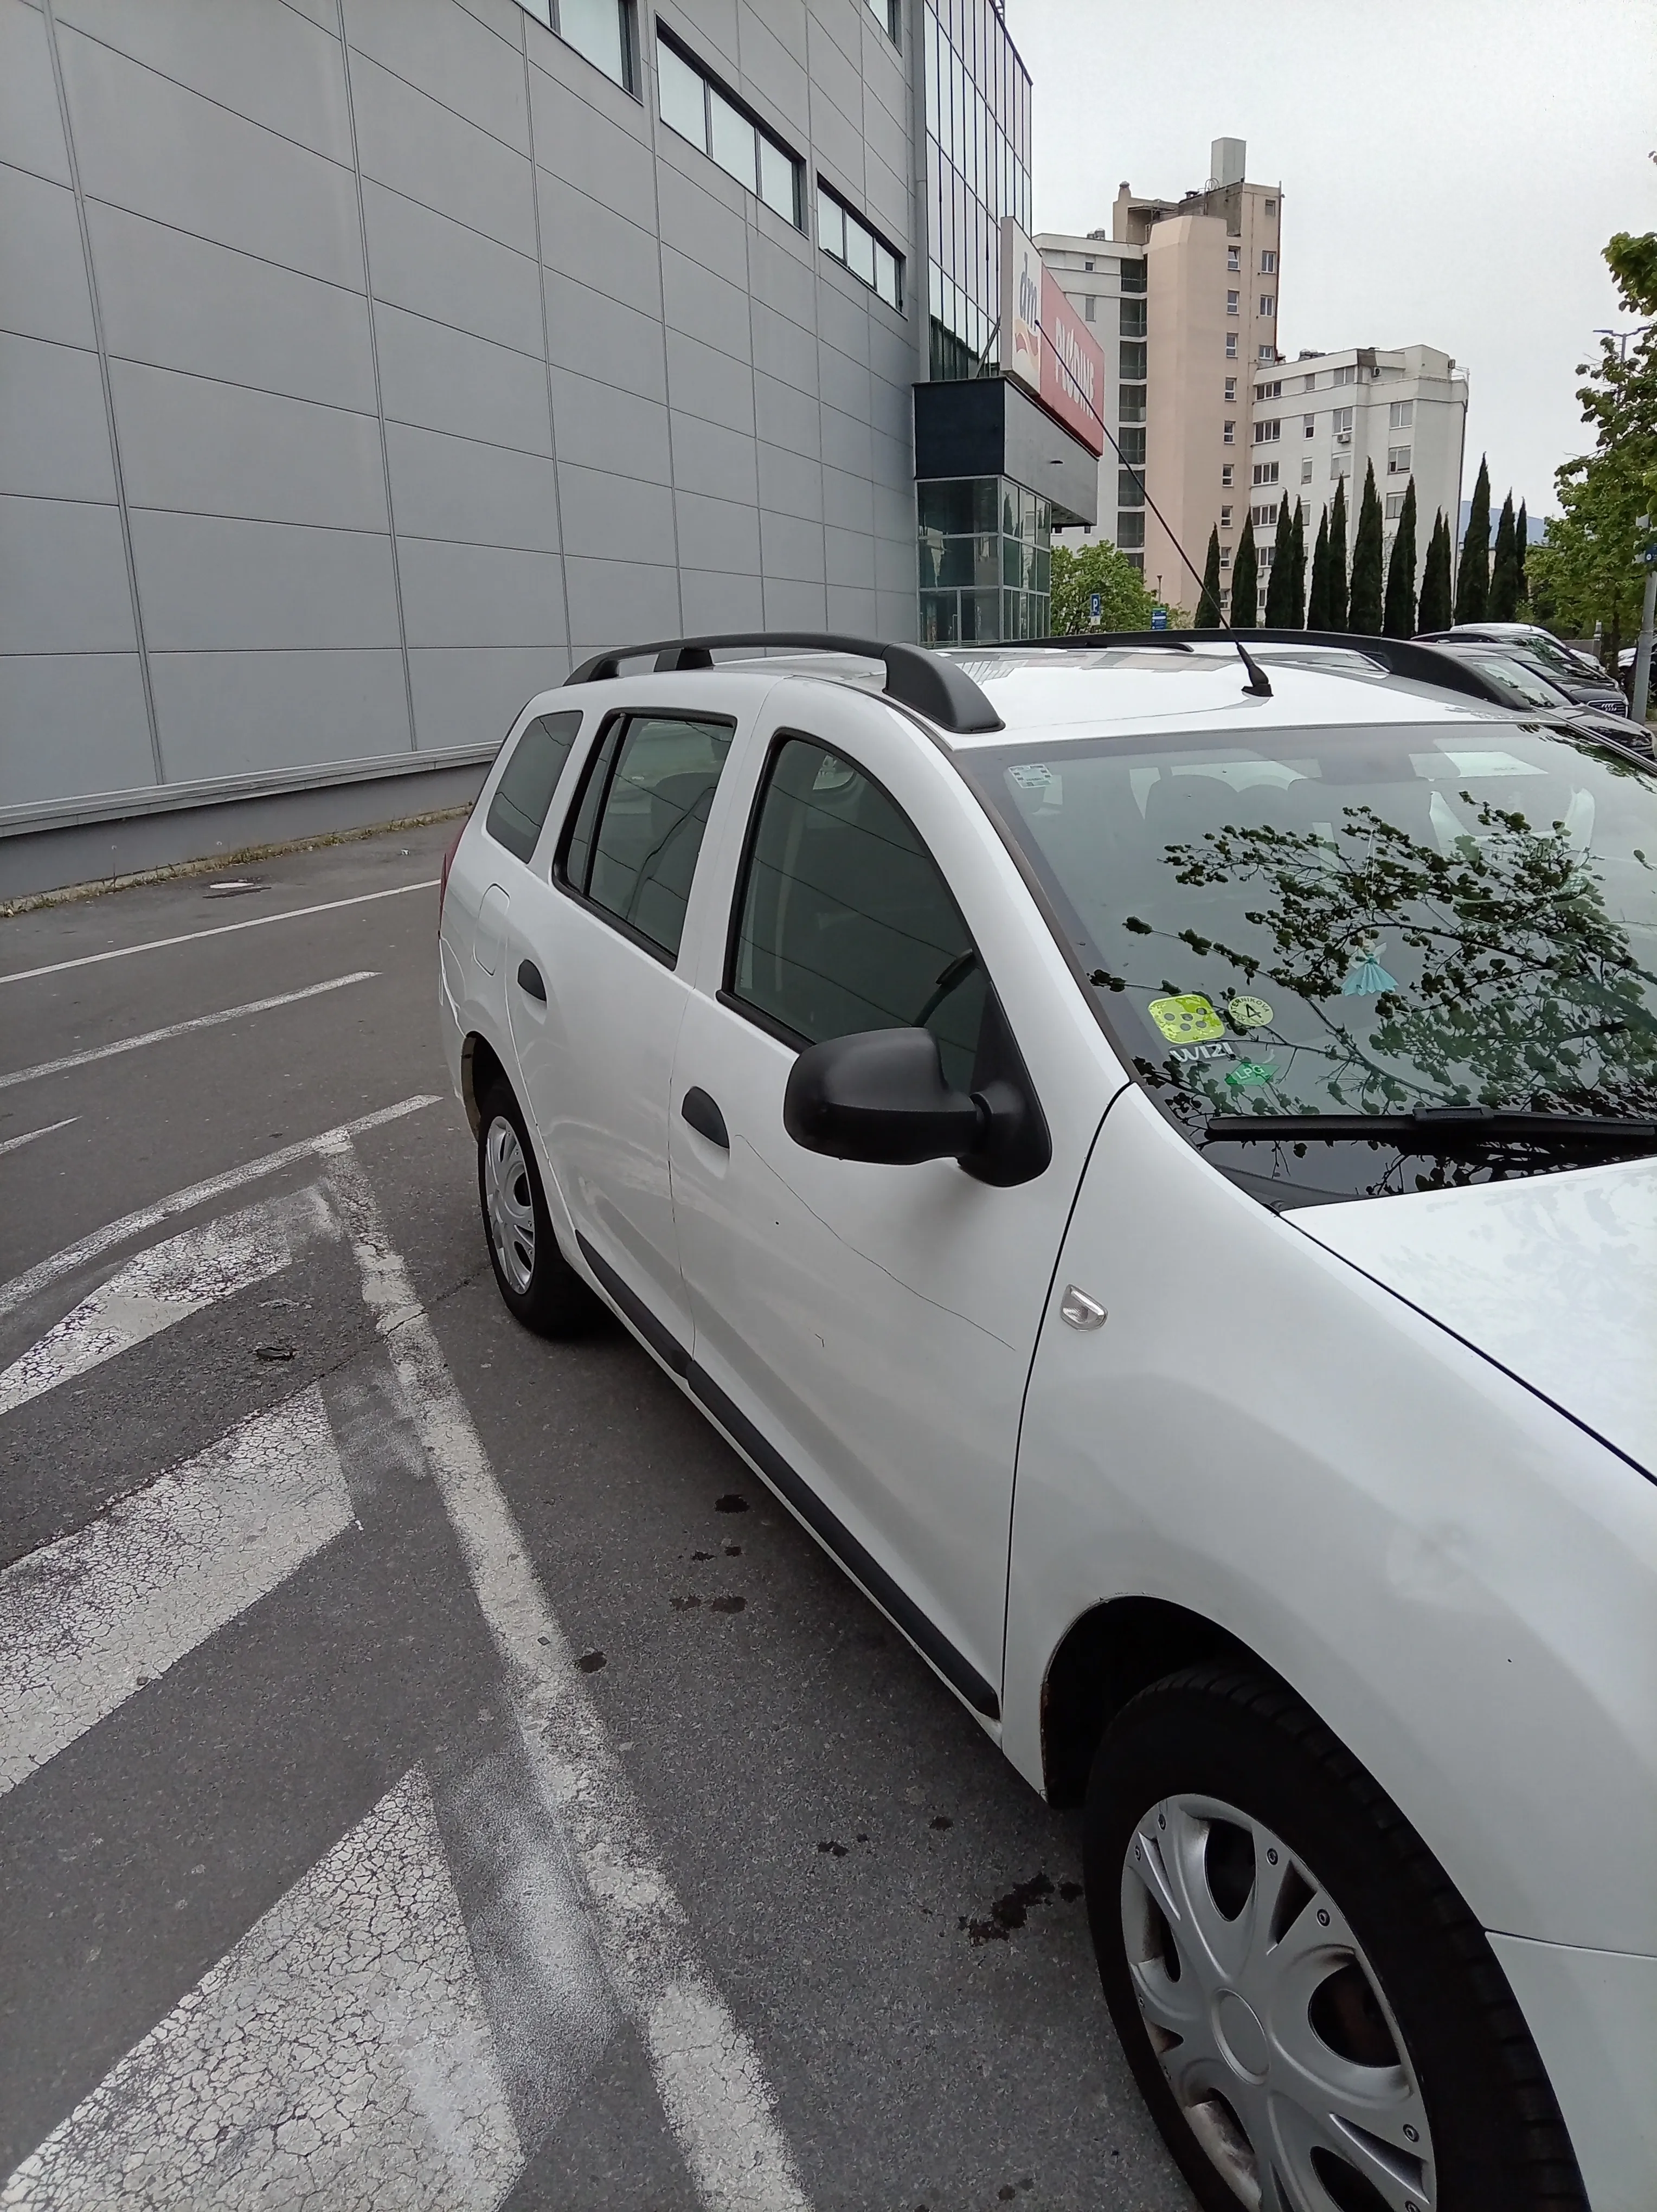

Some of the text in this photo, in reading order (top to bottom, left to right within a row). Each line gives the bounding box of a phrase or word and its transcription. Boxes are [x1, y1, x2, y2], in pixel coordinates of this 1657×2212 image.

[1019, 252, 1037, 332] dm
[1093, 598, 1098, 612] P
[1230, 997, 1270, 1022] KVATERNIKOVA
[1245, 1003, 1262, 1019] 4
[1169, 1042, 1236, 1062] WIZI
[1235, 1065, 1265, 1079] LPG
